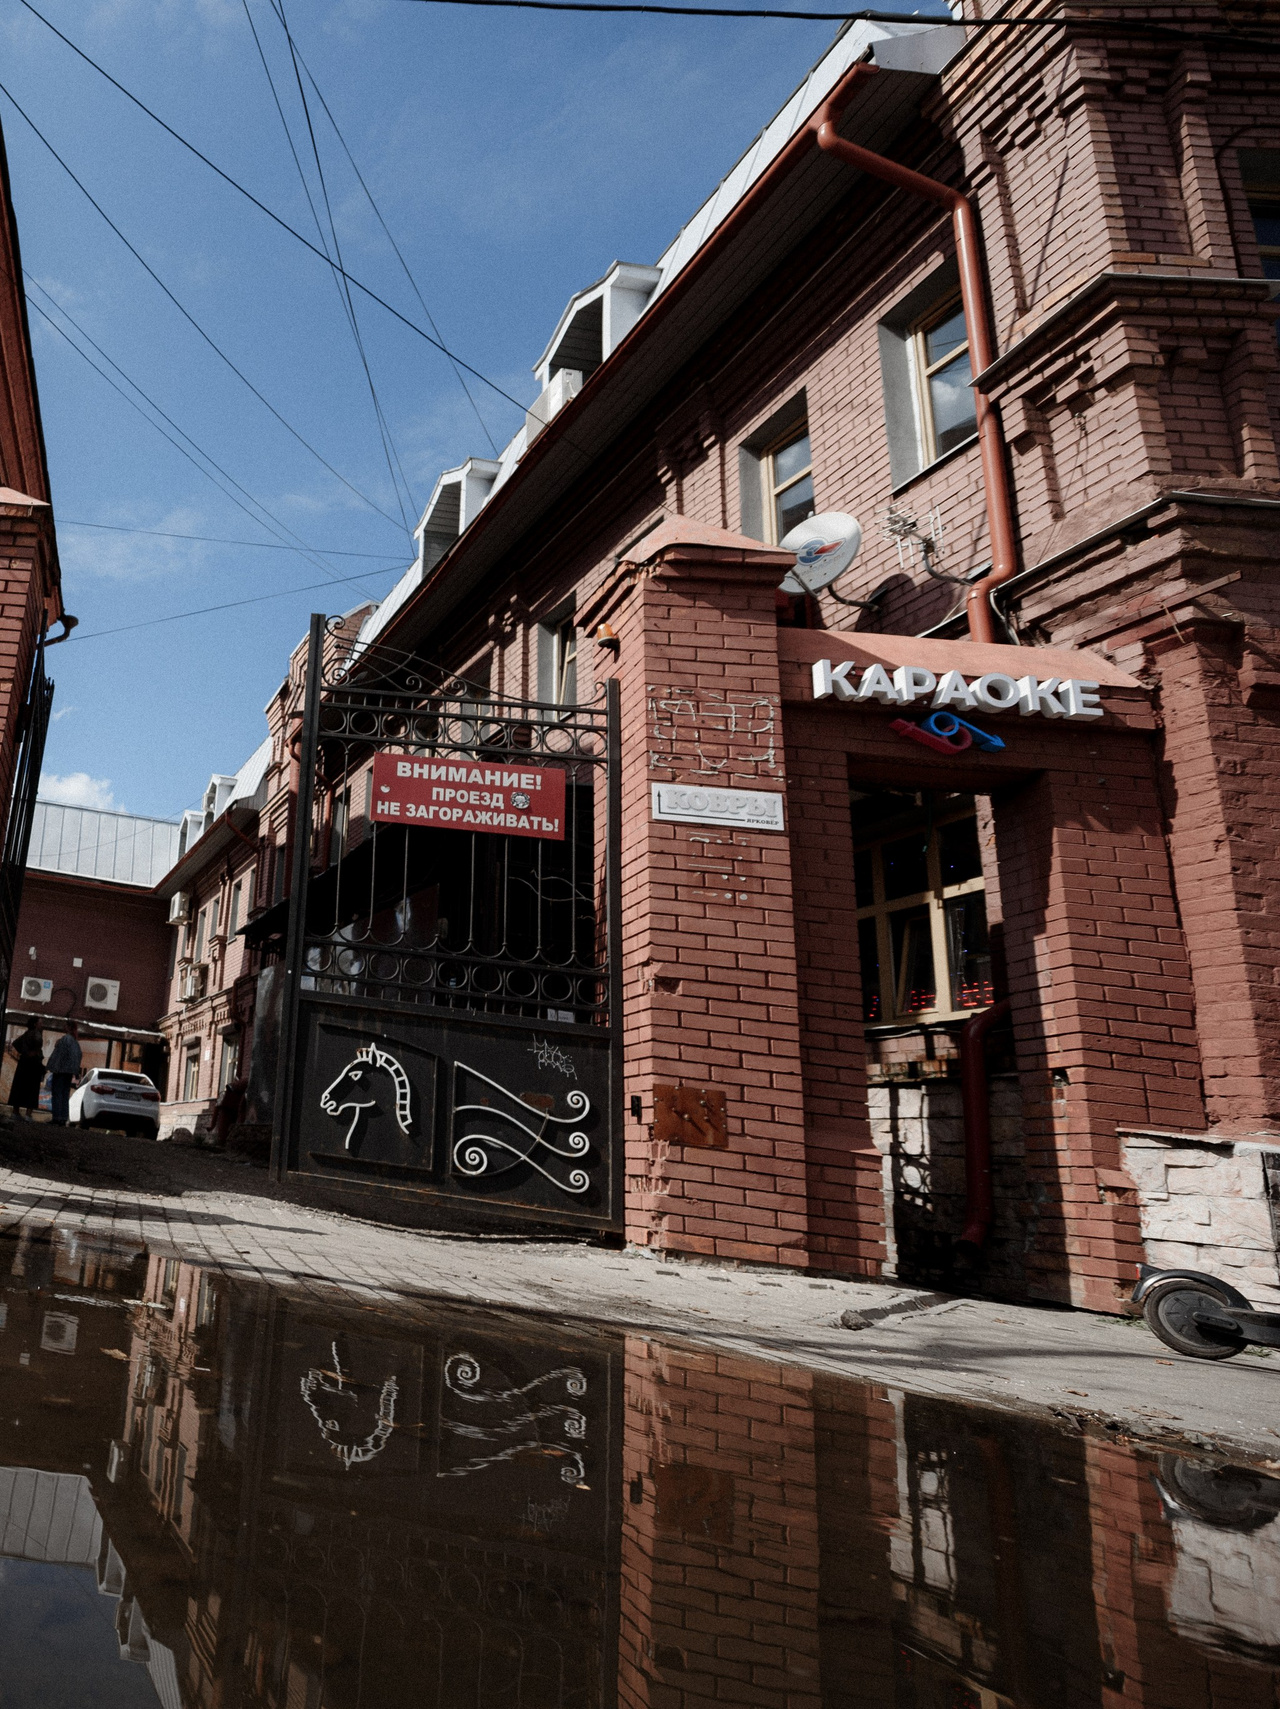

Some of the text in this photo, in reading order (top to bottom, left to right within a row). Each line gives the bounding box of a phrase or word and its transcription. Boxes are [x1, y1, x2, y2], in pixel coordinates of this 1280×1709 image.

[812, 659, 1104, 721] КАРАОКЕ
[397, 762, 542, 790] ВНИМАНИЕ!
[432, 787, 504, 809] ПРОЕЗД
[666, 789, 778, 818] КОВРЫ
[376, 801, 559, 832] НЕ ЗАГОРАЖИВАТЬ!
